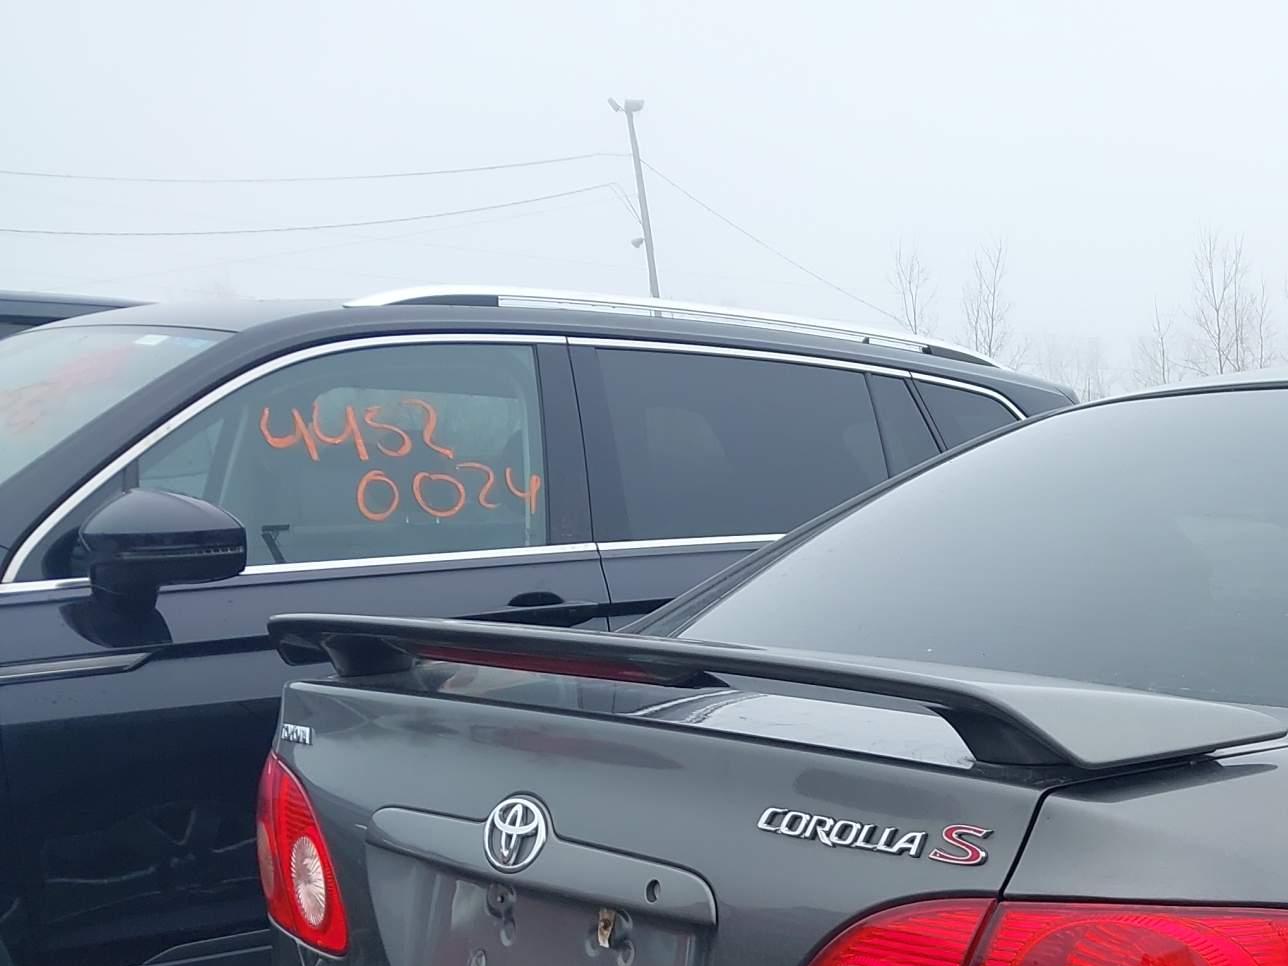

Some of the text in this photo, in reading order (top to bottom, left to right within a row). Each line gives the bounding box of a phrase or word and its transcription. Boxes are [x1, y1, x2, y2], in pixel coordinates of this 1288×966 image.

[356, 461, 541, 521] 0024
[757, 806, 993, 866] COROLLA S
